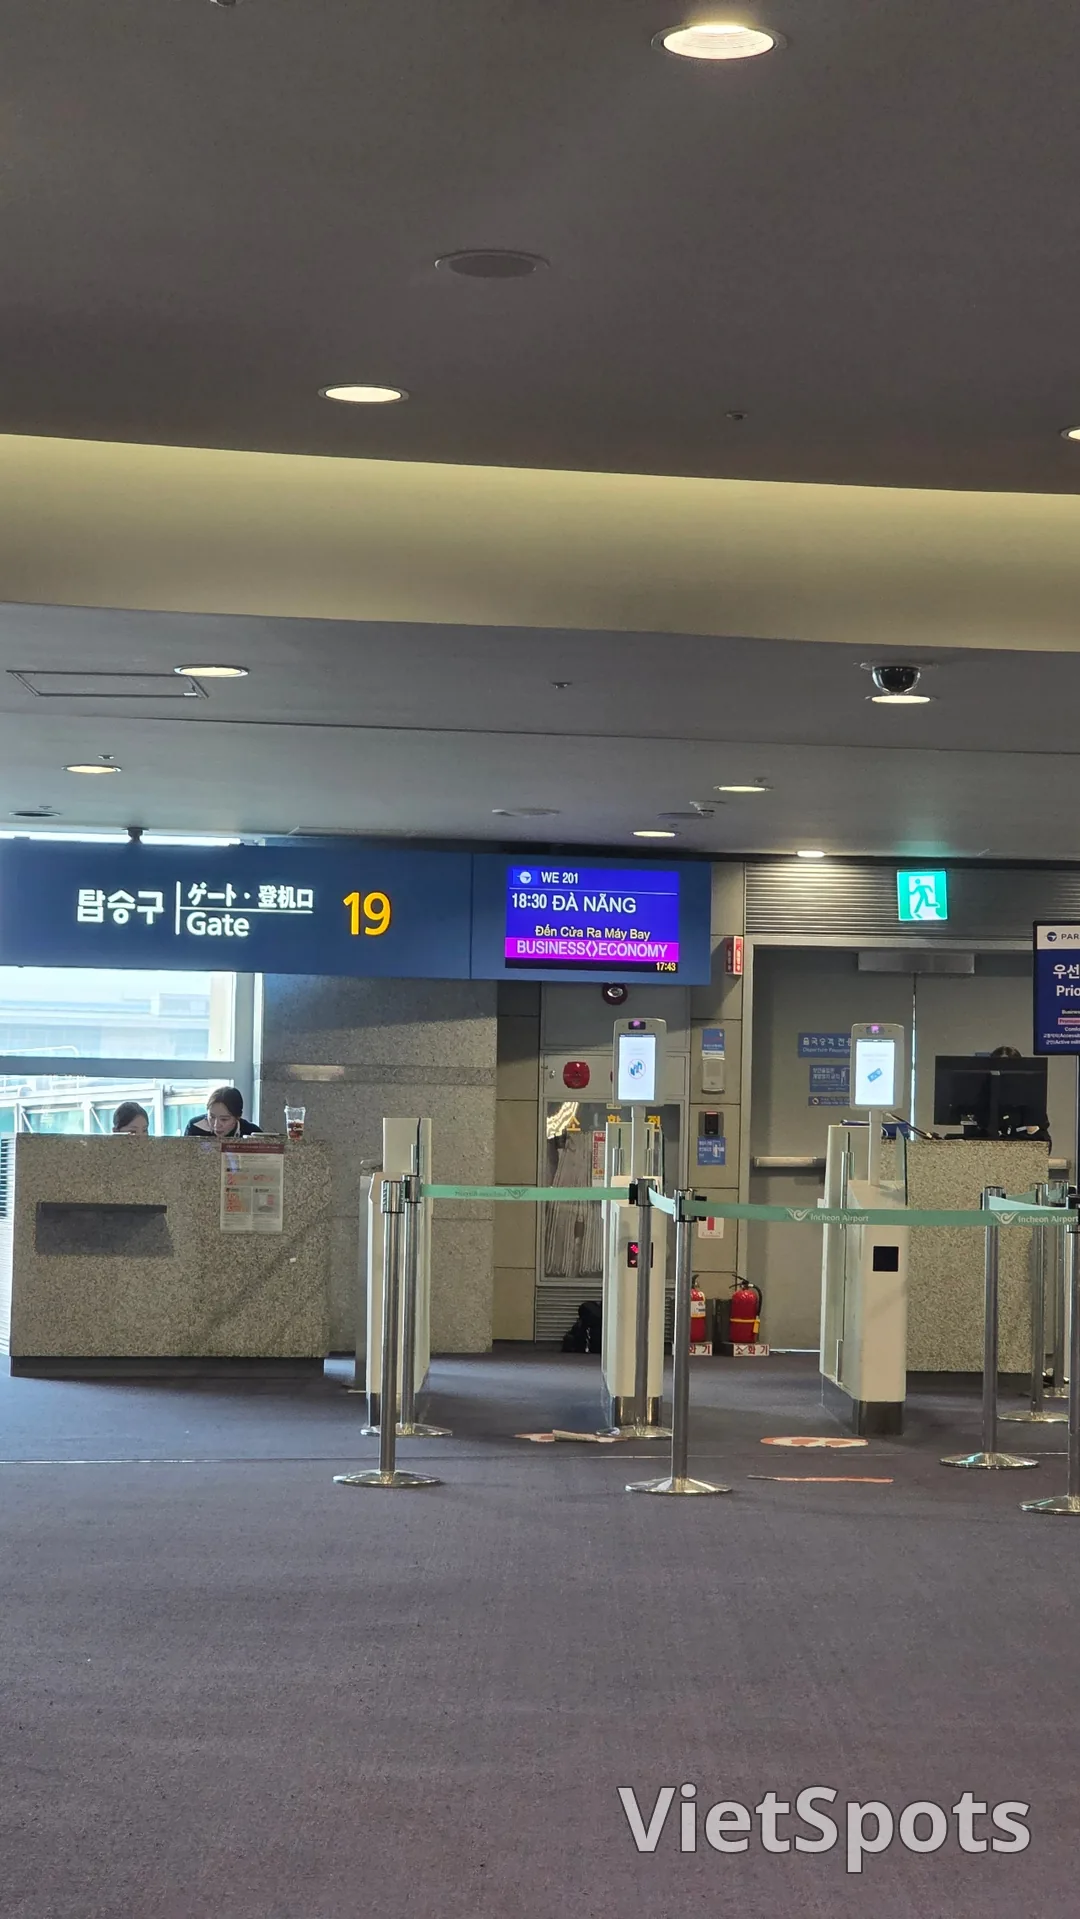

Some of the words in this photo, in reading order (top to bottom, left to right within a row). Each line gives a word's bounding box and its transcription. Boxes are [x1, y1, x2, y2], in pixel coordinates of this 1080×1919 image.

[541, 871, 560, 884] WE
[562, 872, 579, 884] 201
[76, 889, 164, 925] 탑승구
[512, 893, 547, 909] 18:30
[552, 891, 579, 911] ĐÀ
[342, 891, 392, 936] 19
[186, 911, 250, 937] Gate
[535, 923, 557, 937] Đến
[560, 925, 584, 938] Cửa
[586, 927, 602, 938] Ra
[604, 926, 627, 941] Máy
[629, 928, 651, 942] Bay
[656, 962, 676, 972] 17:43
[810, 1213, 840, 1221] Incheon
[842, 1215, 869, 1223] Airport
[1018, 1215, 1049, 1223] Incheon
[1051, 1216, 1079, 1224] Airport
